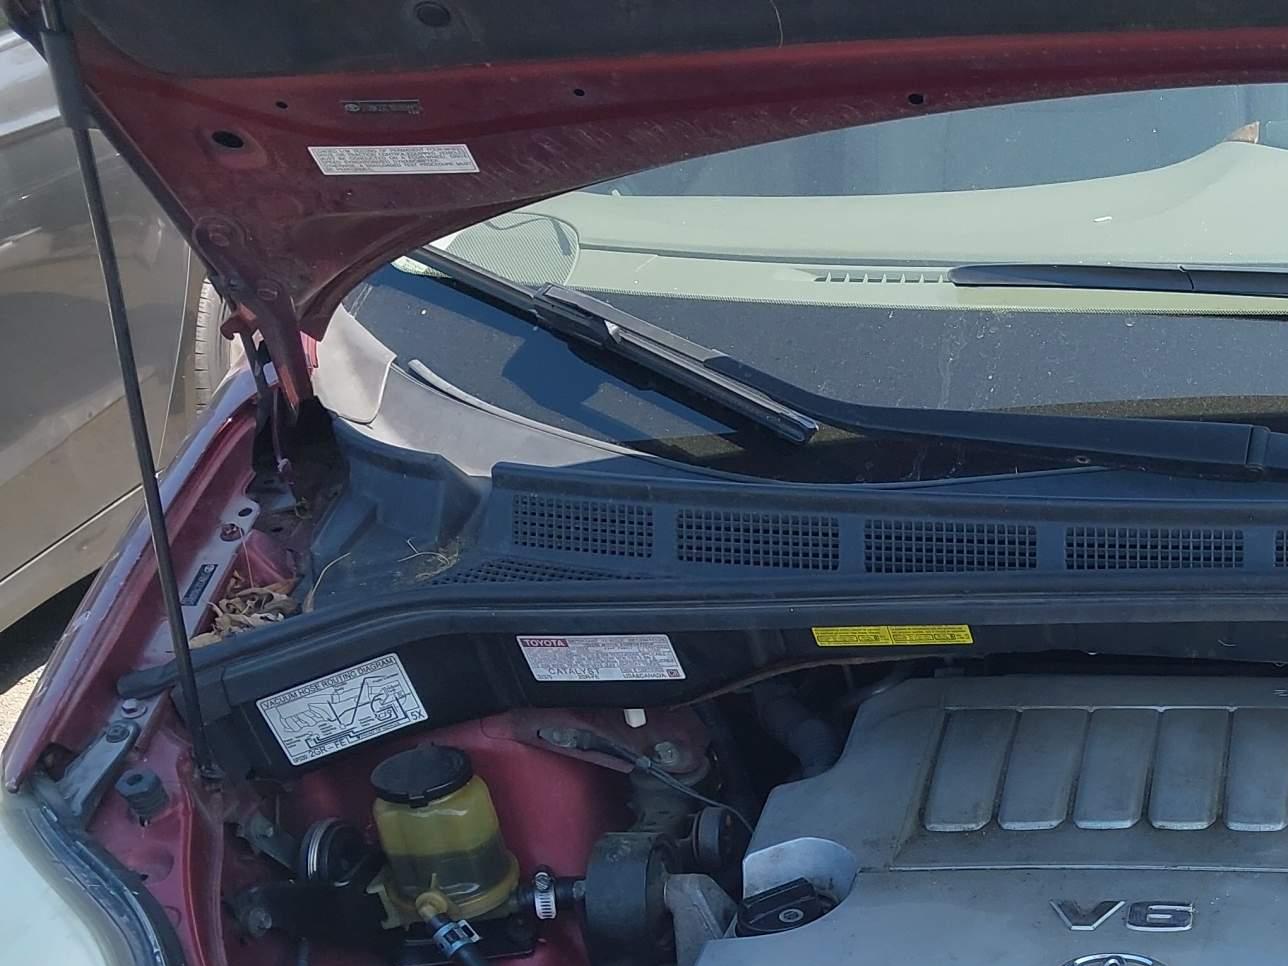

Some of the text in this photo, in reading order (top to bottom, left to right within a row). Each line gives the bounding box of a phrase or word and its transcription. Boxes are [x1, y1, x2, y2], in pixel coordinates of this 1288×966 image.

[263, 657, 395, 709] VACUUM HOSE ROUTING DIAGRAM
[411, 710, 424, 721] 5X
[1050, 900, 1193, 932] V6
